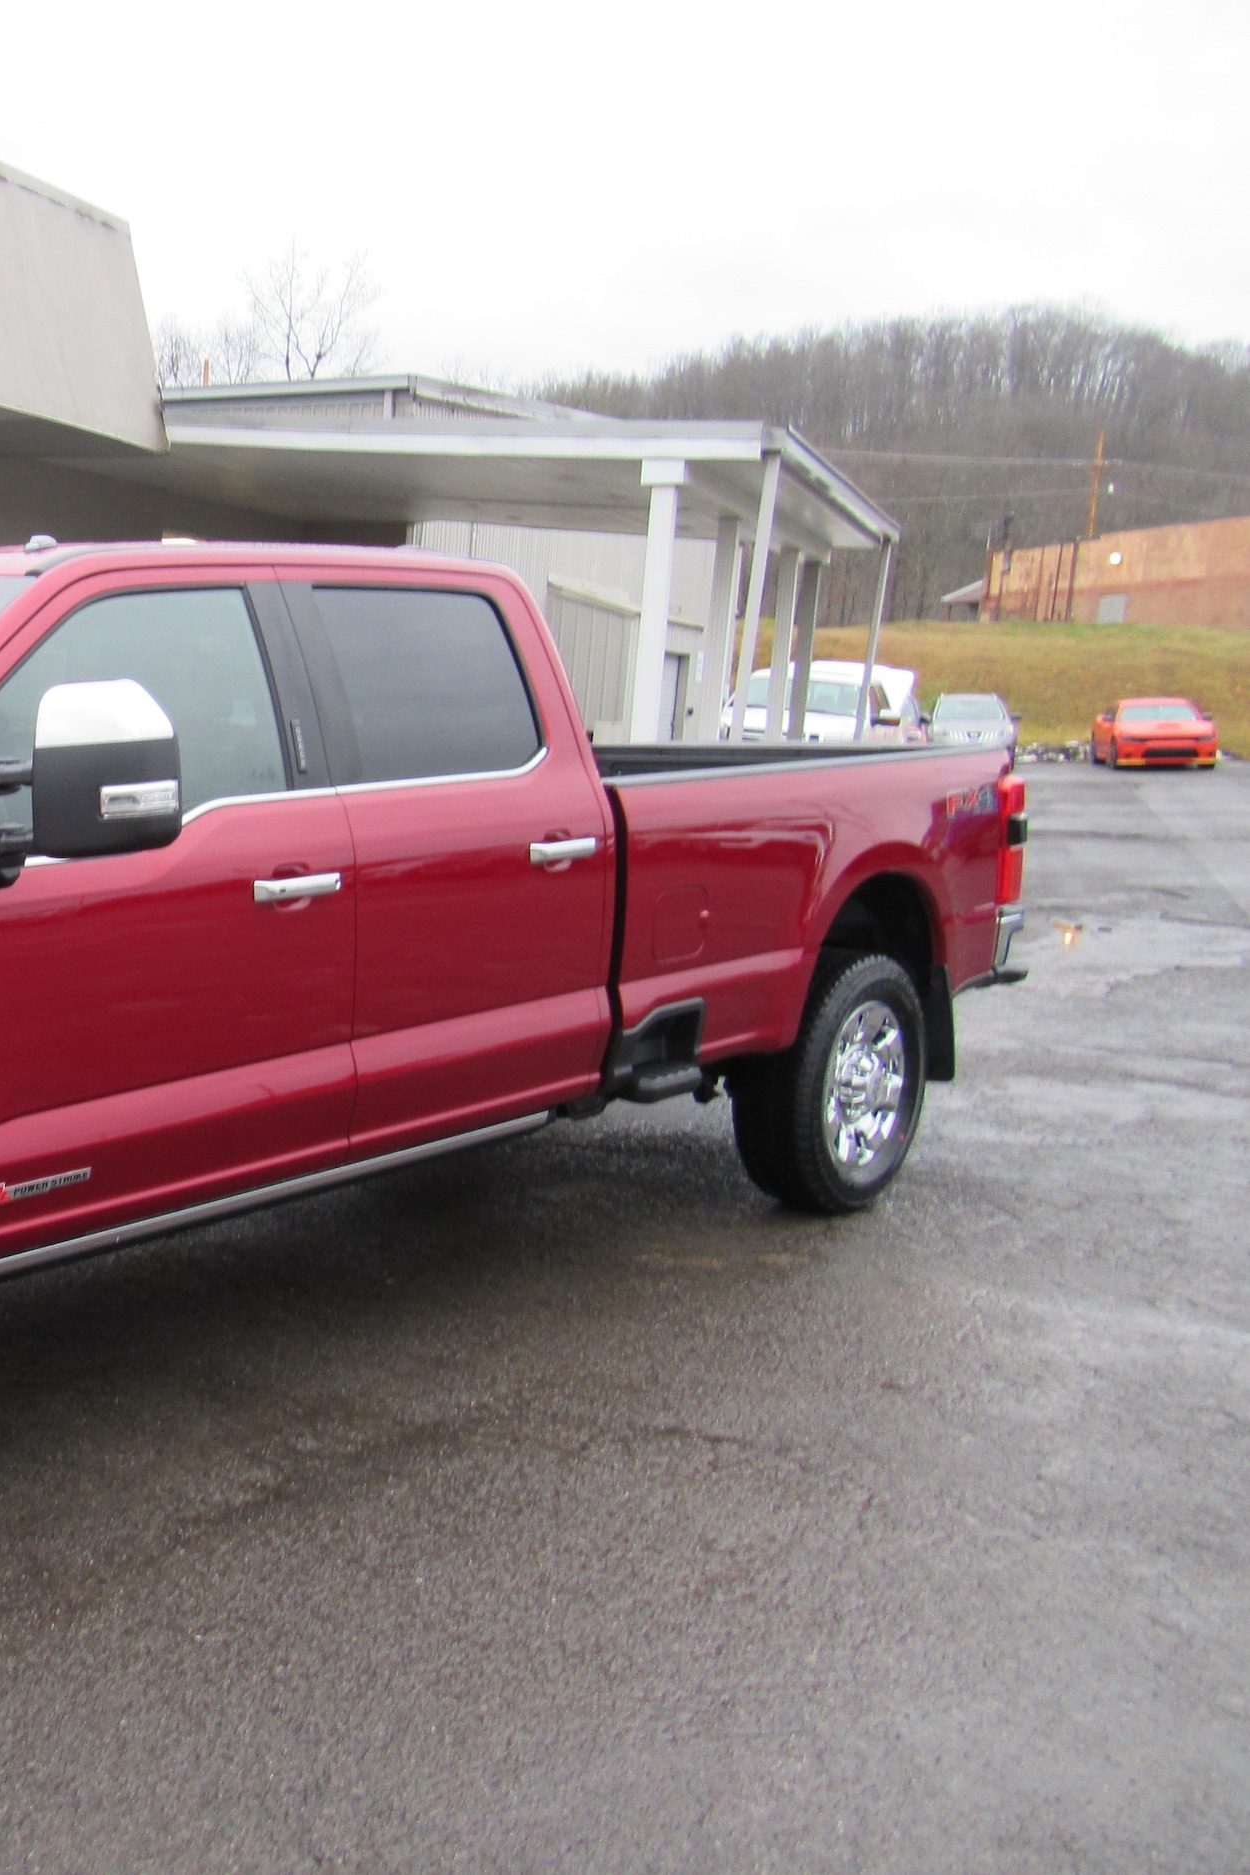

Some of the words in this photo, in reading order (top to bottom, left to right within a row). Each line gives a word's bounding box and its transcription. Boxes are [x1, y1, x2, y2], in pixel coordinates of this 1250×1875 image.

[947, 784, 995, 819] FX4
[13, 1181, 49, 1198] POWER
[49, 1171, 89, 1188] STROKE
